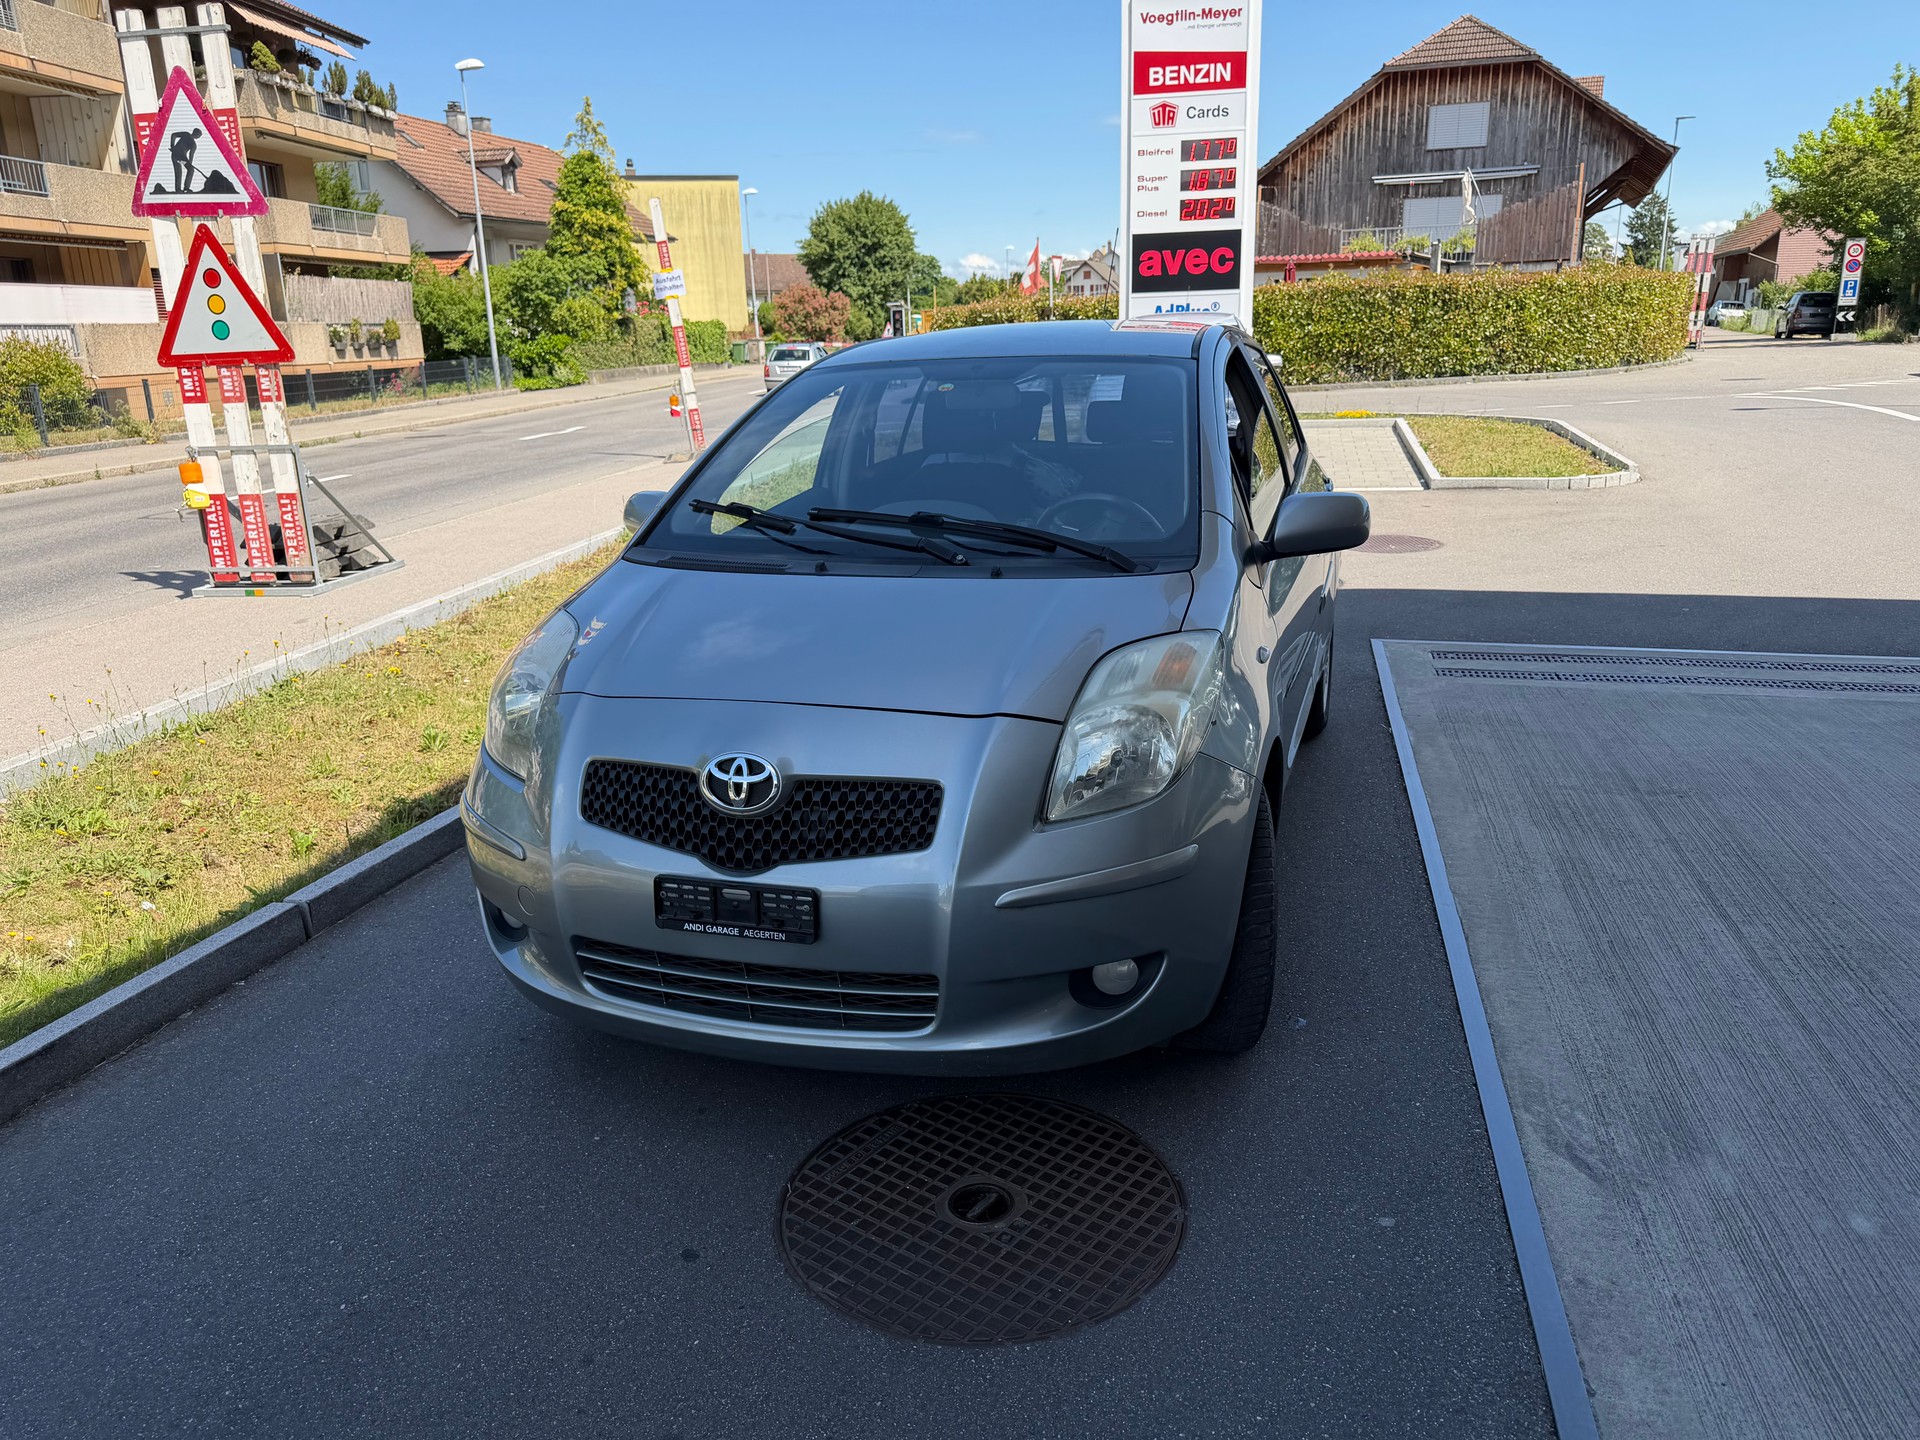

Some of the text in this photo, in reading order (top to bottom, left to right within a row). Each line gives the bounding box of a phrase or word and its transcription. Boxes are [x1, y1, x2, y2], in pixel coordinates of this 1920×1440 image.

[1140, 8, 1243, 26] Voegtlin-Meyer
[1148, 62, 1232, 87] BENZIN
[1186, 105, 1229, 119] Cards
[1137, 148, 1174, 157] Bleifrei
[1137, 175, 1168, 184] Super
[1137, 185, 1160, 193] Plus
[1136, 210, 1168, 219] Diesel
[1138, 247, 1235, 277] avec
[655, 275, 681, 285] Ausfahrt
[683, 923, 786, 941] ANDI GARAGE AEGERTEN
